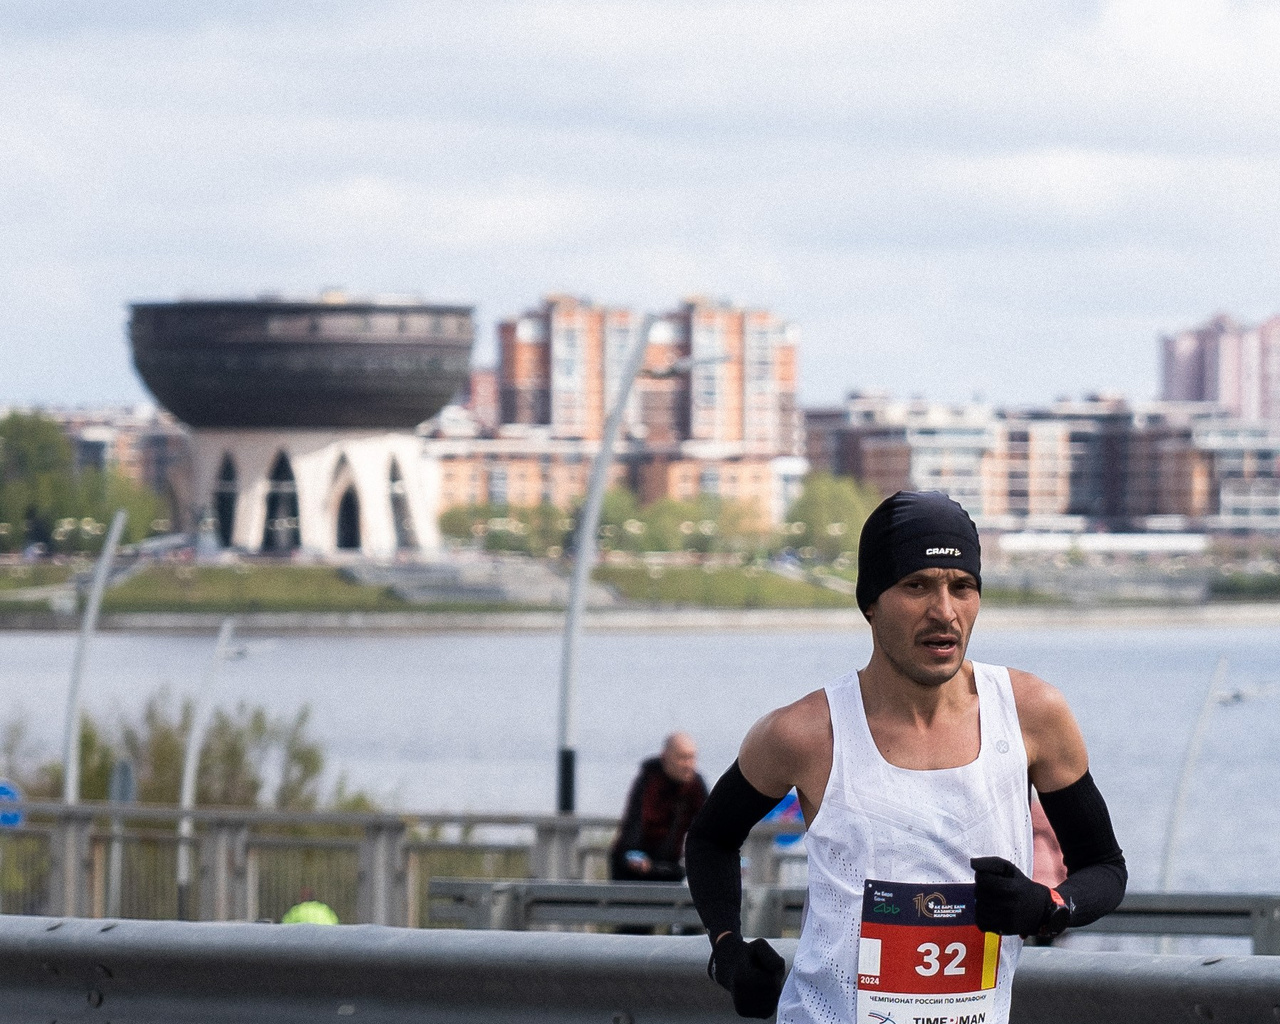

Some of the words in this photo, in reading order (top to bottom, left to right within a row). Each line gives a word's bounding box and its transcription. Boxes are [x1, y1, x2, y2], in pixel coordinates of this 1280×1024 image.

[926, 547, 955, 556] CRAFT
[914, 942, 967, 977] 32
[860, 976, 880, 985] 2024
[869, 995, 914, 1005] ЧЕМПИОНАТ
[955, 994, 987, 1004] МАРАФОНУ
